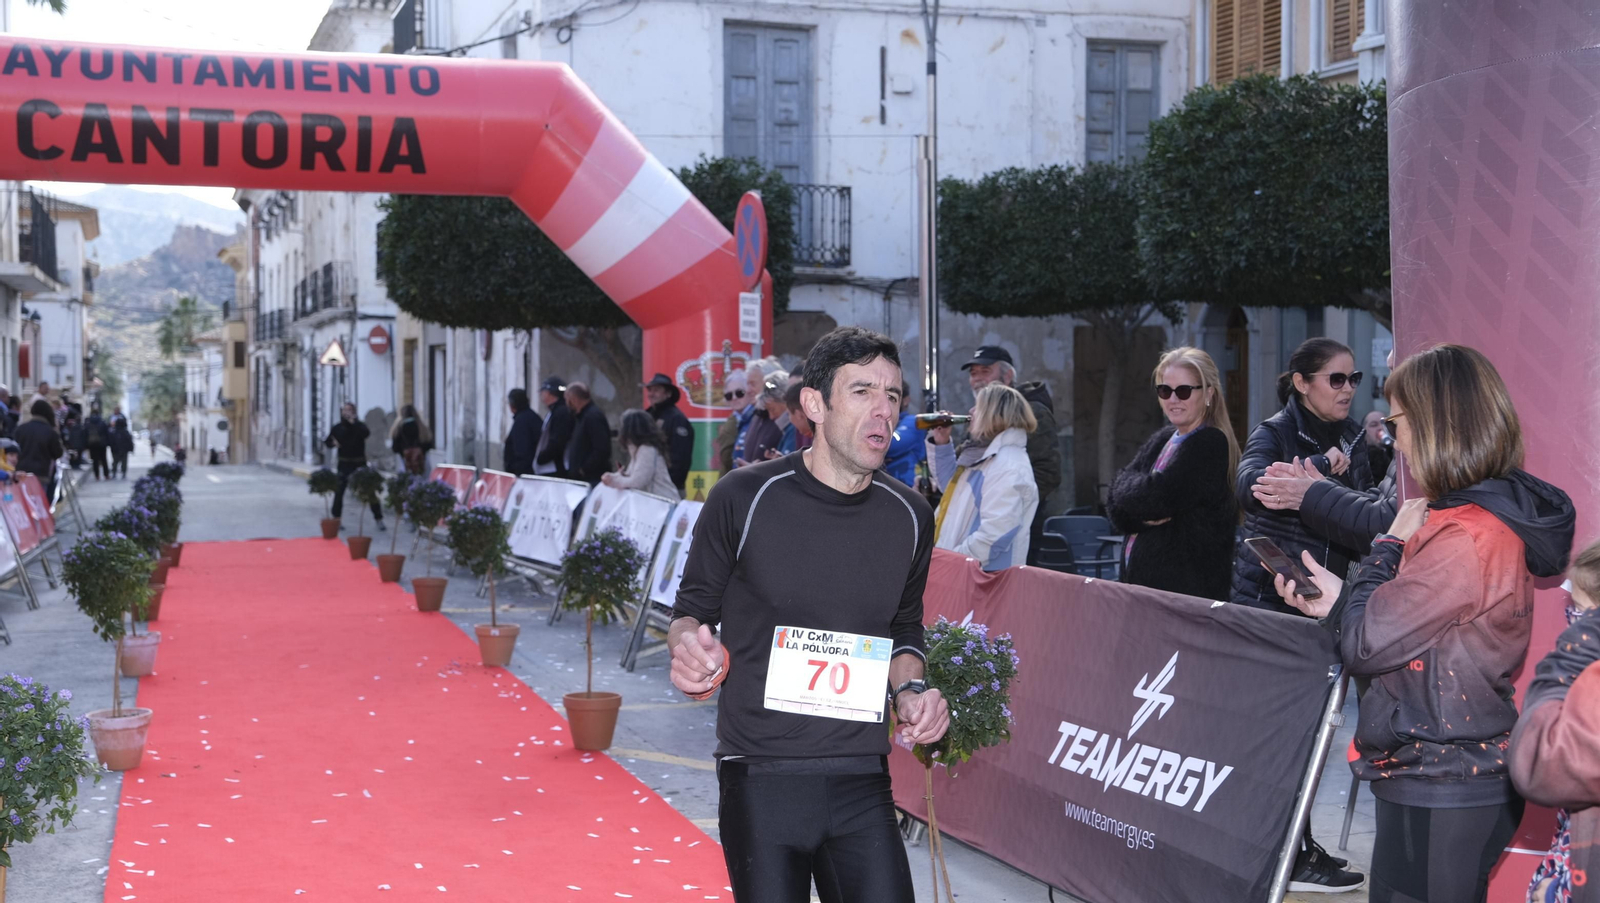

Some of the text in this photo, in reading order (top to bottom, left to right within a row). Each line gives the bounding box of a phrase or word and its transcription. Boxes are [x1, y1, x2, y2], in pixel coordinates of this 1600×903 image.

[2, 44, 440, 96] AYUNTAMIENTO
[17, 99, 427, 175] CANTORIA
[786, 641, 798, 650] LA
[802, 642, 849, 656] PÓLVORA
[791, 629, 804, 639] IV
[808, 631, 834, 643] CxM
[807, 659, 851, 695] 70
[1048, 721, 1234, 813] TEAMERGY
[1064, 801, 1156, 850] www.teamergy.es
